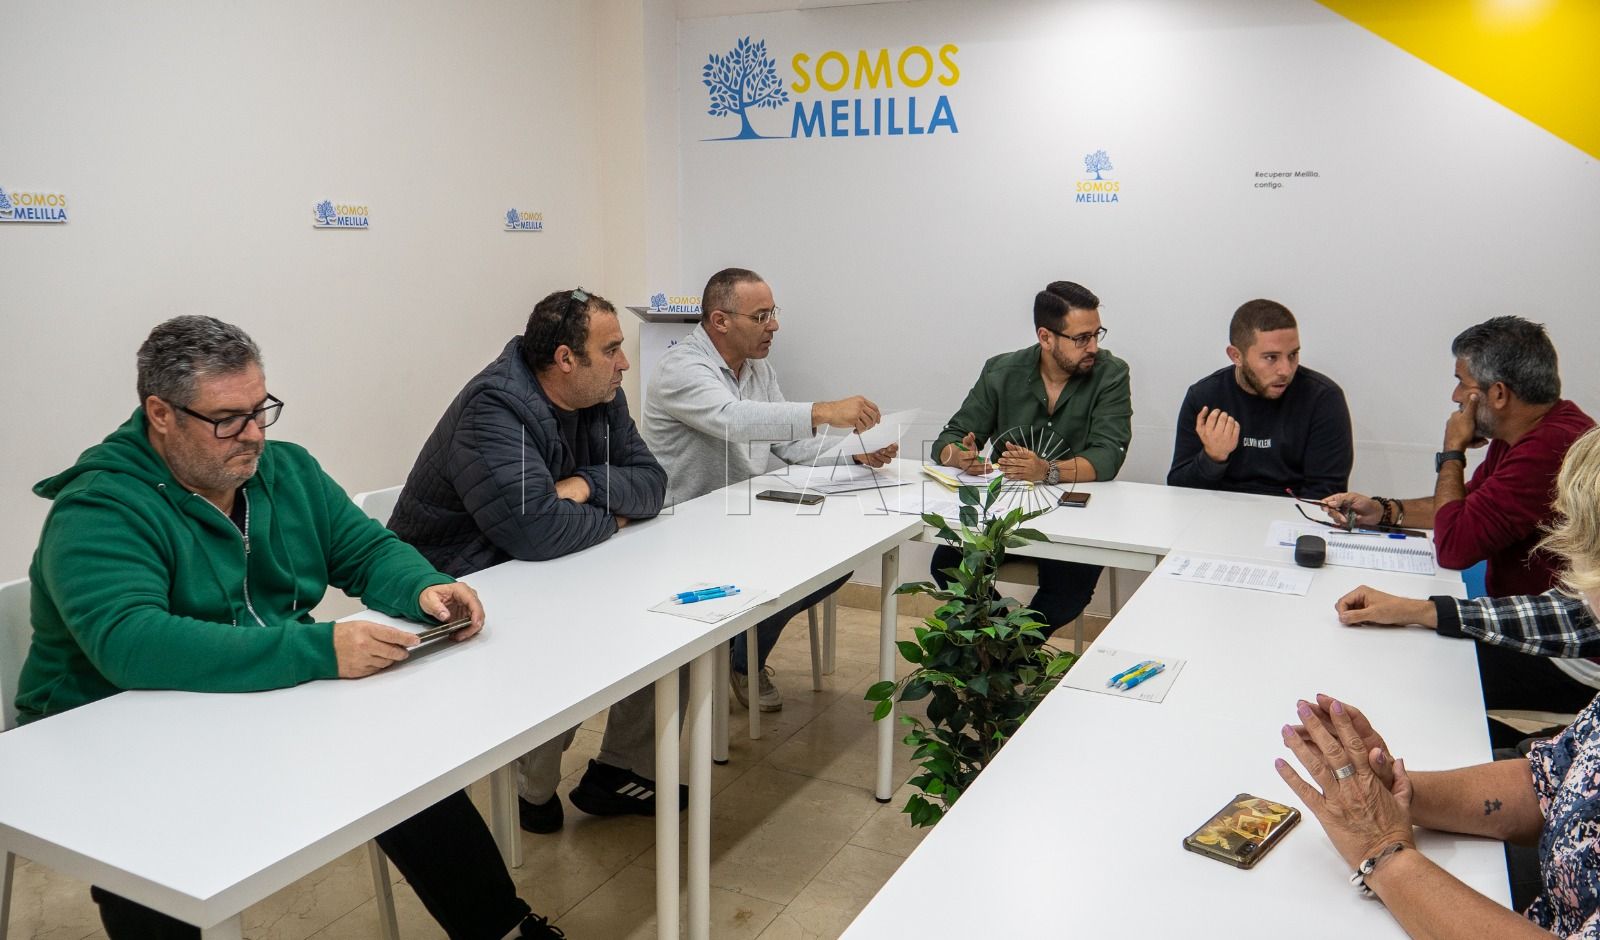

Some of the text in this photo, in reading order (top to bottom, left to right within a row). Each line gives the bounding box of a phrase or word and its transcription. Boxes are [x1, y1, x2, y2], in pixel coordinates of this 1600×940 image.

[791, 43, 961, 94] SOMOS
[790, 95, 959, 138] MELILLA
[1075, 181, 1120, 192] SOMOS
[12, 192, 66, 207] SOMOS
[1075, 193, 1119, 203] MELILLA
[14, 207, 67, 220] MELILLA
[336, 205, 369, 216] SOMOS
[337, 216, 369, 226] MELILLA
[668, 296, 701, 305] SOMOS
[668, 305, 700, 313] MELILLA
